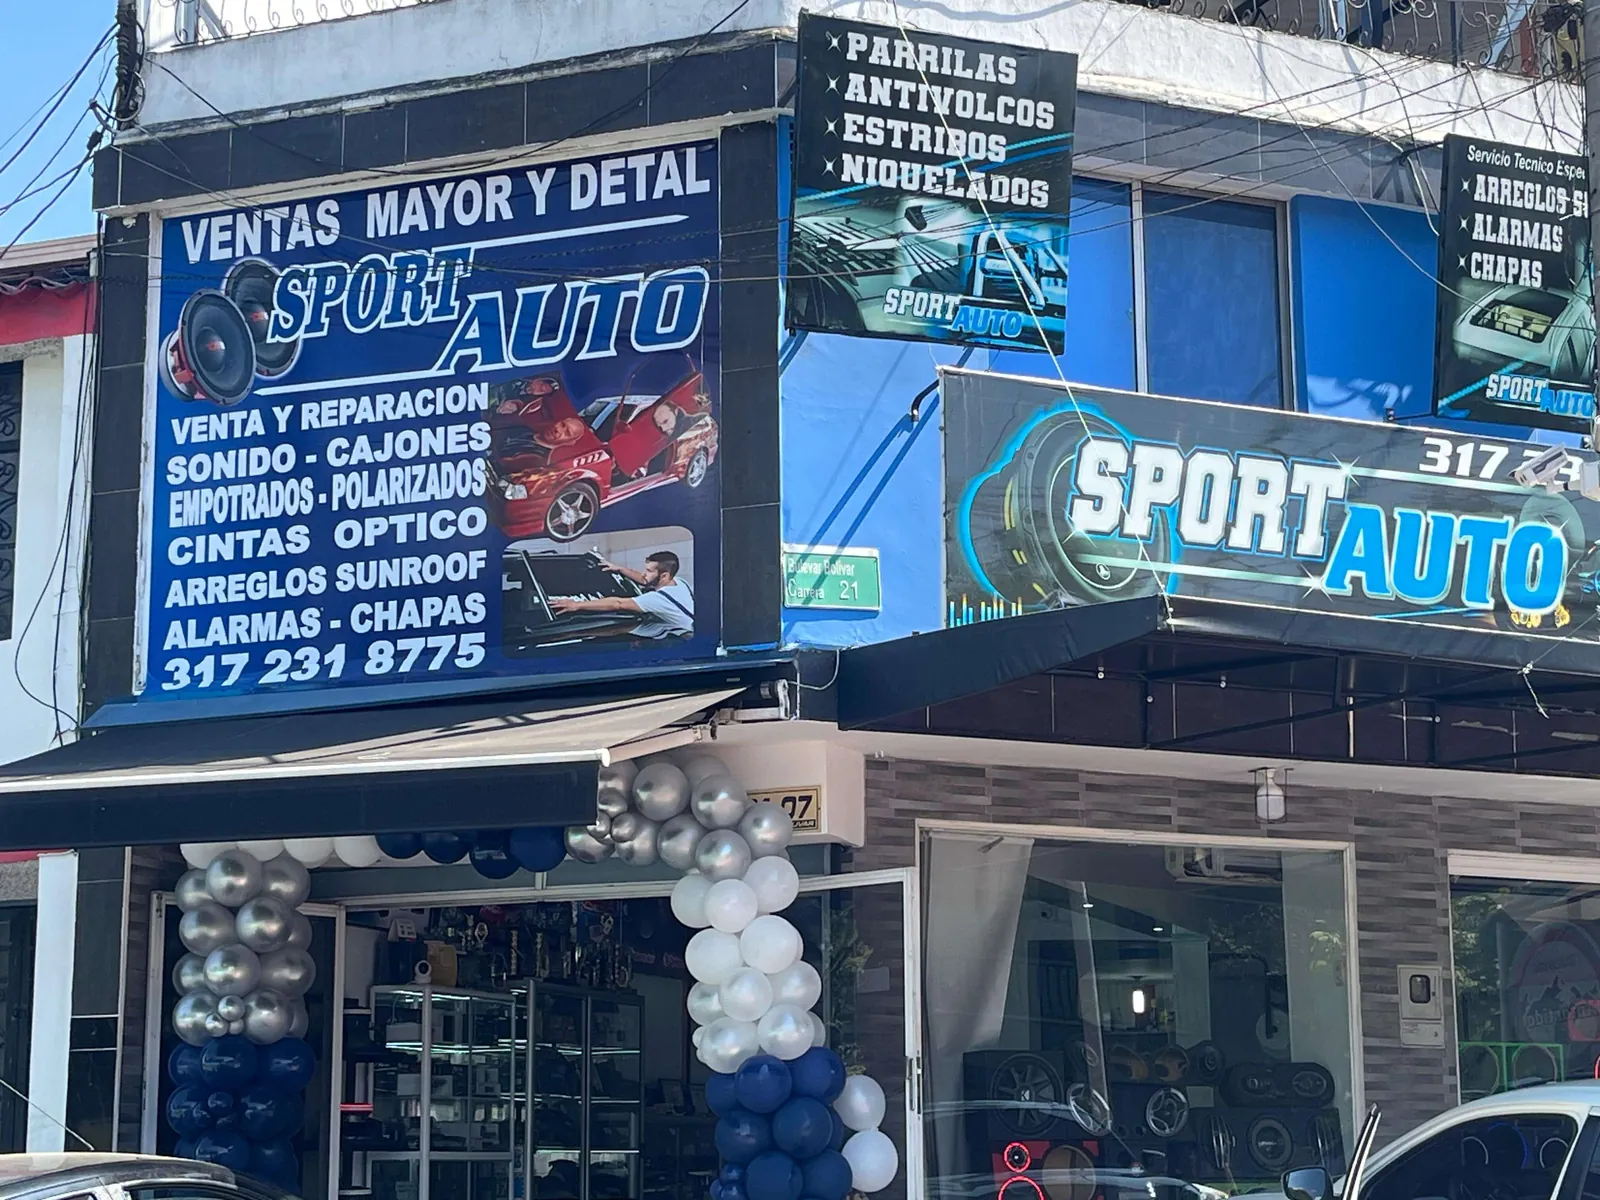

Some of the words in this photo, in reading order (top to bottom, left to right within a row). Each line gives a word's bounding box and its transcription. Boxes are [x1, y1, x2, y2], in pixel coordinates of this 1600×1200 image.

[846, 31, 1017, 85] PARRILAS
[844, 72, 1055, 130] ANTIVOLCOS
[842, 112, 1007, 164] ESTRIBOS
[1467, 145, 1511, 167] Servicio
[1514, 152, 1554, 174] Tecnico
[181, 199, 340, 264] VENTAS
[366, 175, 515, 238] MAYOR
[526, 168, 557, 216] Y
[570, 146, 711, 211] DETAL
[840, 153, 1049, 209] NIQUELADOS
[1474, 174, 1567, 215] ARREGLOS
[1472, 213, 1563, 253] ALARMAS
[1470, 251, 1543, 288] CHAPAS
[266, 245, 478, 344] SPORT
[432, 265, 711, 377] AUTO
[883, 287, 962, 320] SPORT
[951, 305, 1023, 338] AUTO
[171, 408, 265, 445] VENTA
[272, 405, 294, 433] Y
[301, 382, 490, 431] REPARACION
[1486, 373, 1548, 403] SPORT
[1540, 386, 1595, 418] AUTO
[166, 443, 296, 485] SONIDO
[326, 421, 492, 468] CAJONES
[1418, 436, 1509, 480] 317
[168, 476, 314, 528] EMPOTRADOS
[331, 456, 487, 512] POLARIZADOS
[167, 524, 311, 566] CINTAS
[333, 506, 488, 549] OPTICO
[1067, 436, 1351, 560] SPORT
[1323, 503, 1571, 617] AUTO
[164, 565, 327, 609] ARREGLOS
[335, 549, 488, 593] SUNROOF
[788, 558, 821, 574] Bulevar
[788, 578, 824, 599] Carrera
[840, 580, 858, 600] 21
[162, 607, 321, 651] ALARMAS
[350, 592, 487, 634] CHAPAS
[161, 652, 251, 691] 317
[258, 643, 346, 685] 231
[363, 631, 486, 676] 8775
